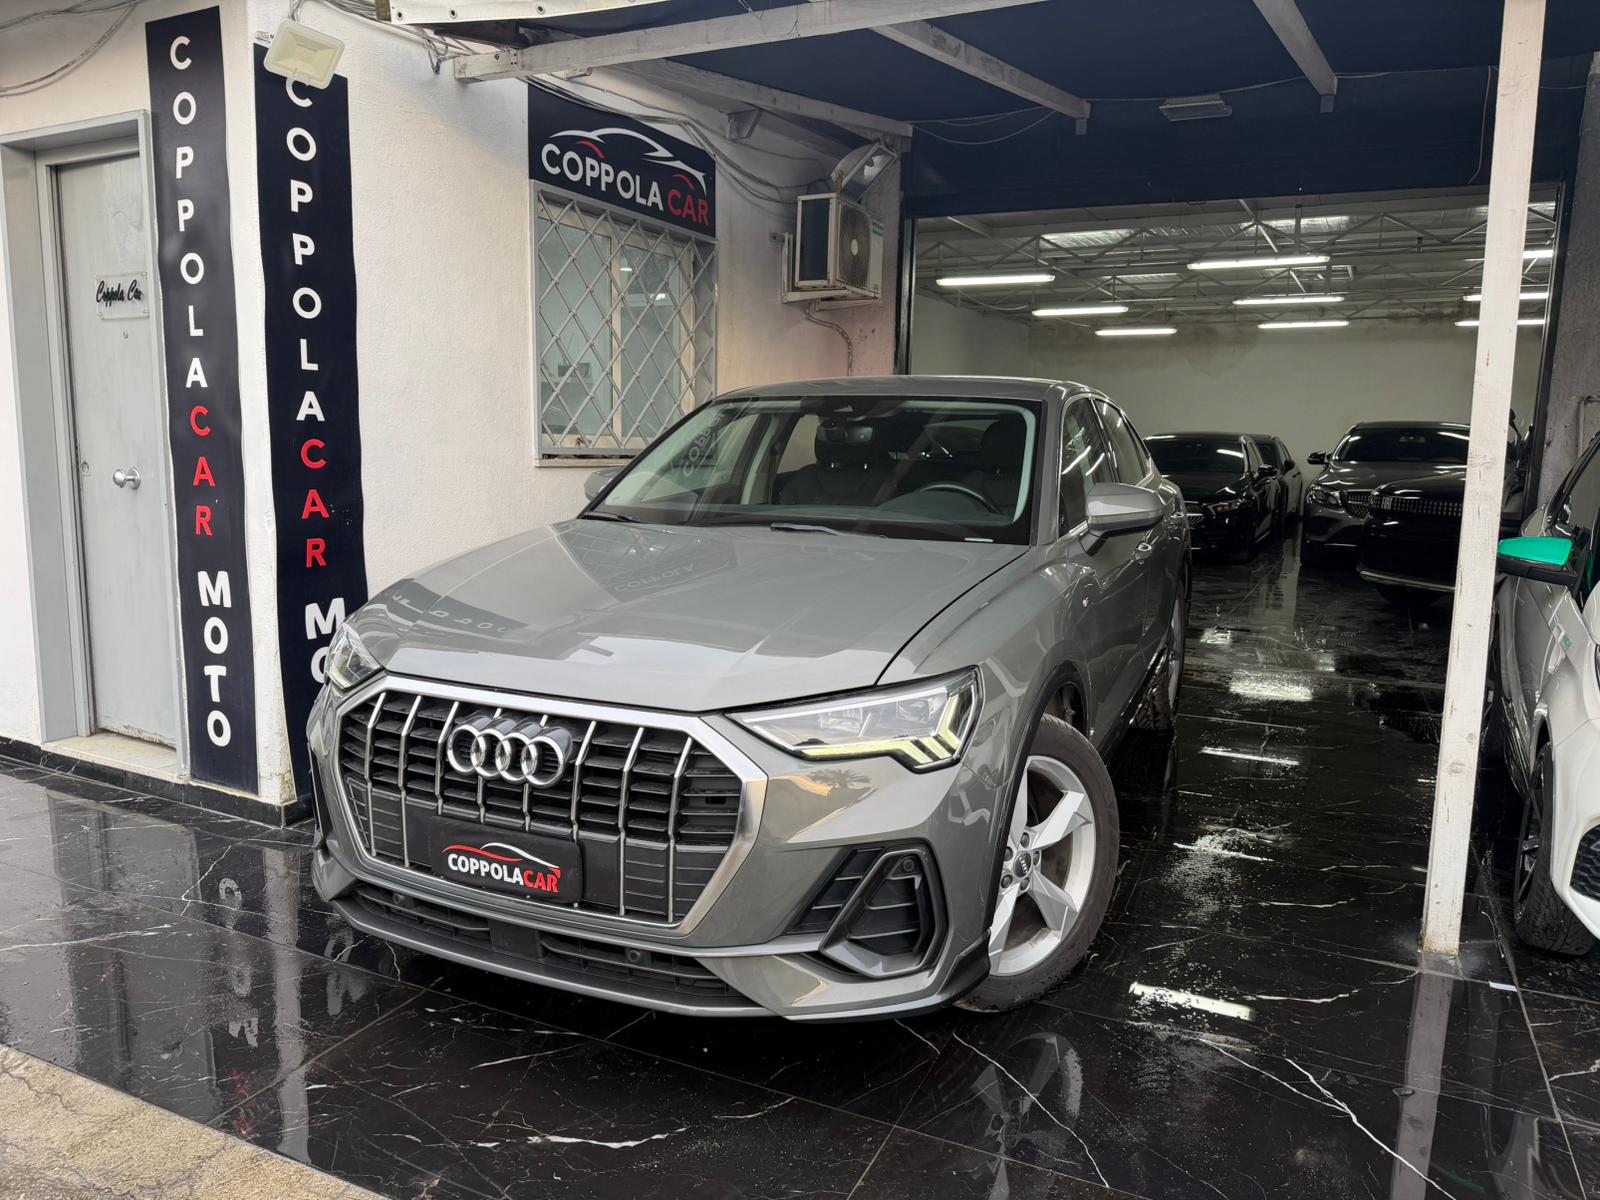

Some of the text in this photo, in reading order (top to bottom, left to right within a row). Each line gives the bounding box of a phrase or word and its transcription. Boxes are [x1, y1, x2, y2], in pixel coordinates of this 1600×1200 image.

[541, 143, 709, 226] COPPOLA CAR
[197, 570, 232, 747] MOTO
